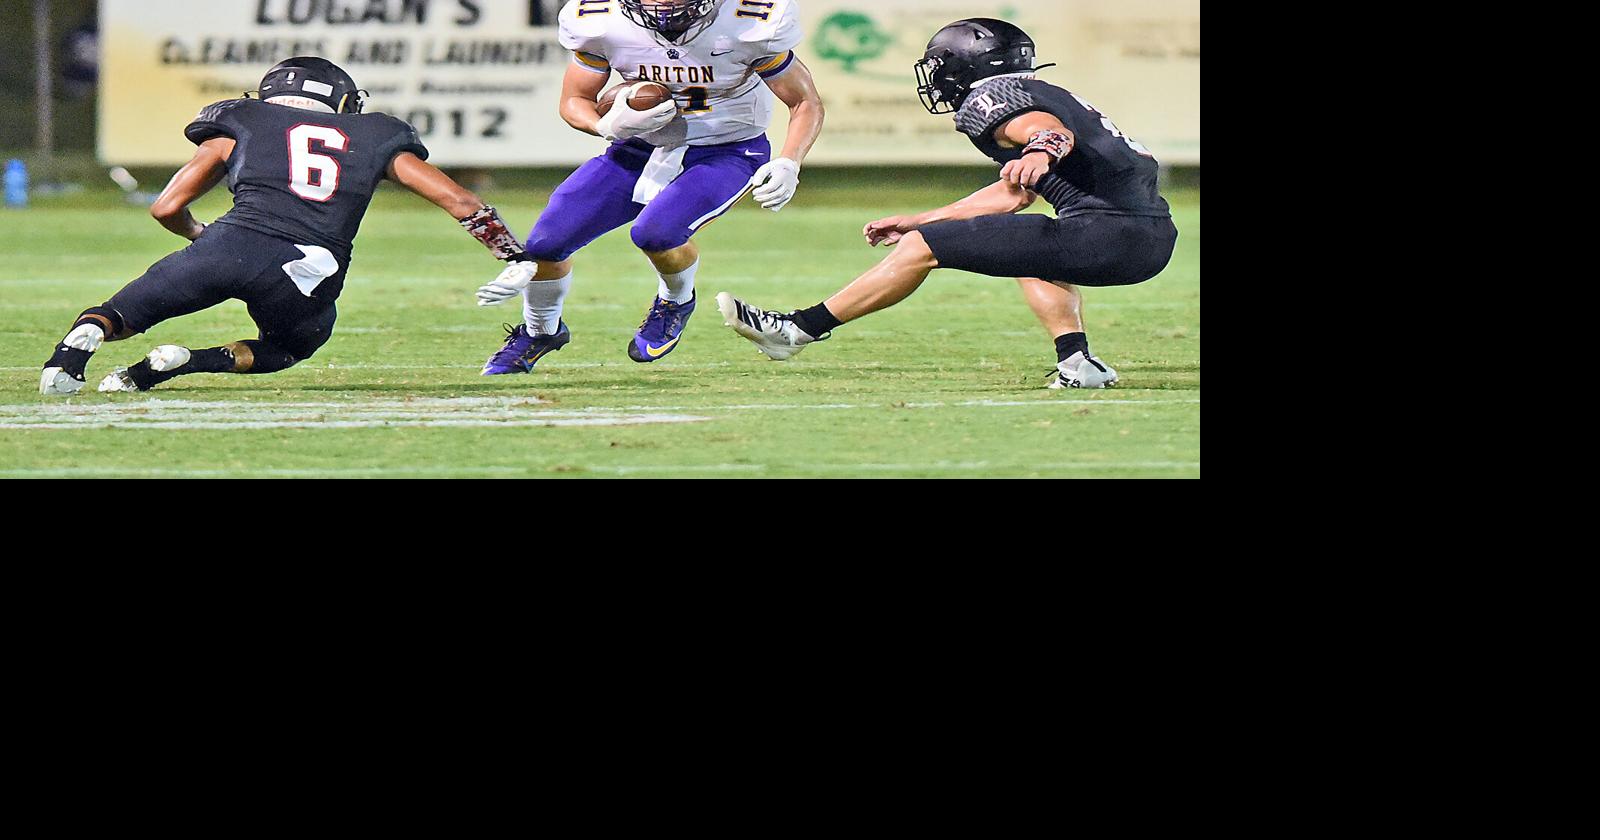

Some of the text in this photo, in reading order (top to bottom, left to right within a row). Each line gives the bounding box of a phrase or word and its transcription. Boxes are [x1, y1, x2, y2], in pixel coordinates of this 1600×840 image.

[255, 0, 481, 25] LOGANS
[638, 64, 715, 83] ARITON
[378, 106, 507, 137] 012
[287, 121, 350, 203] 6
